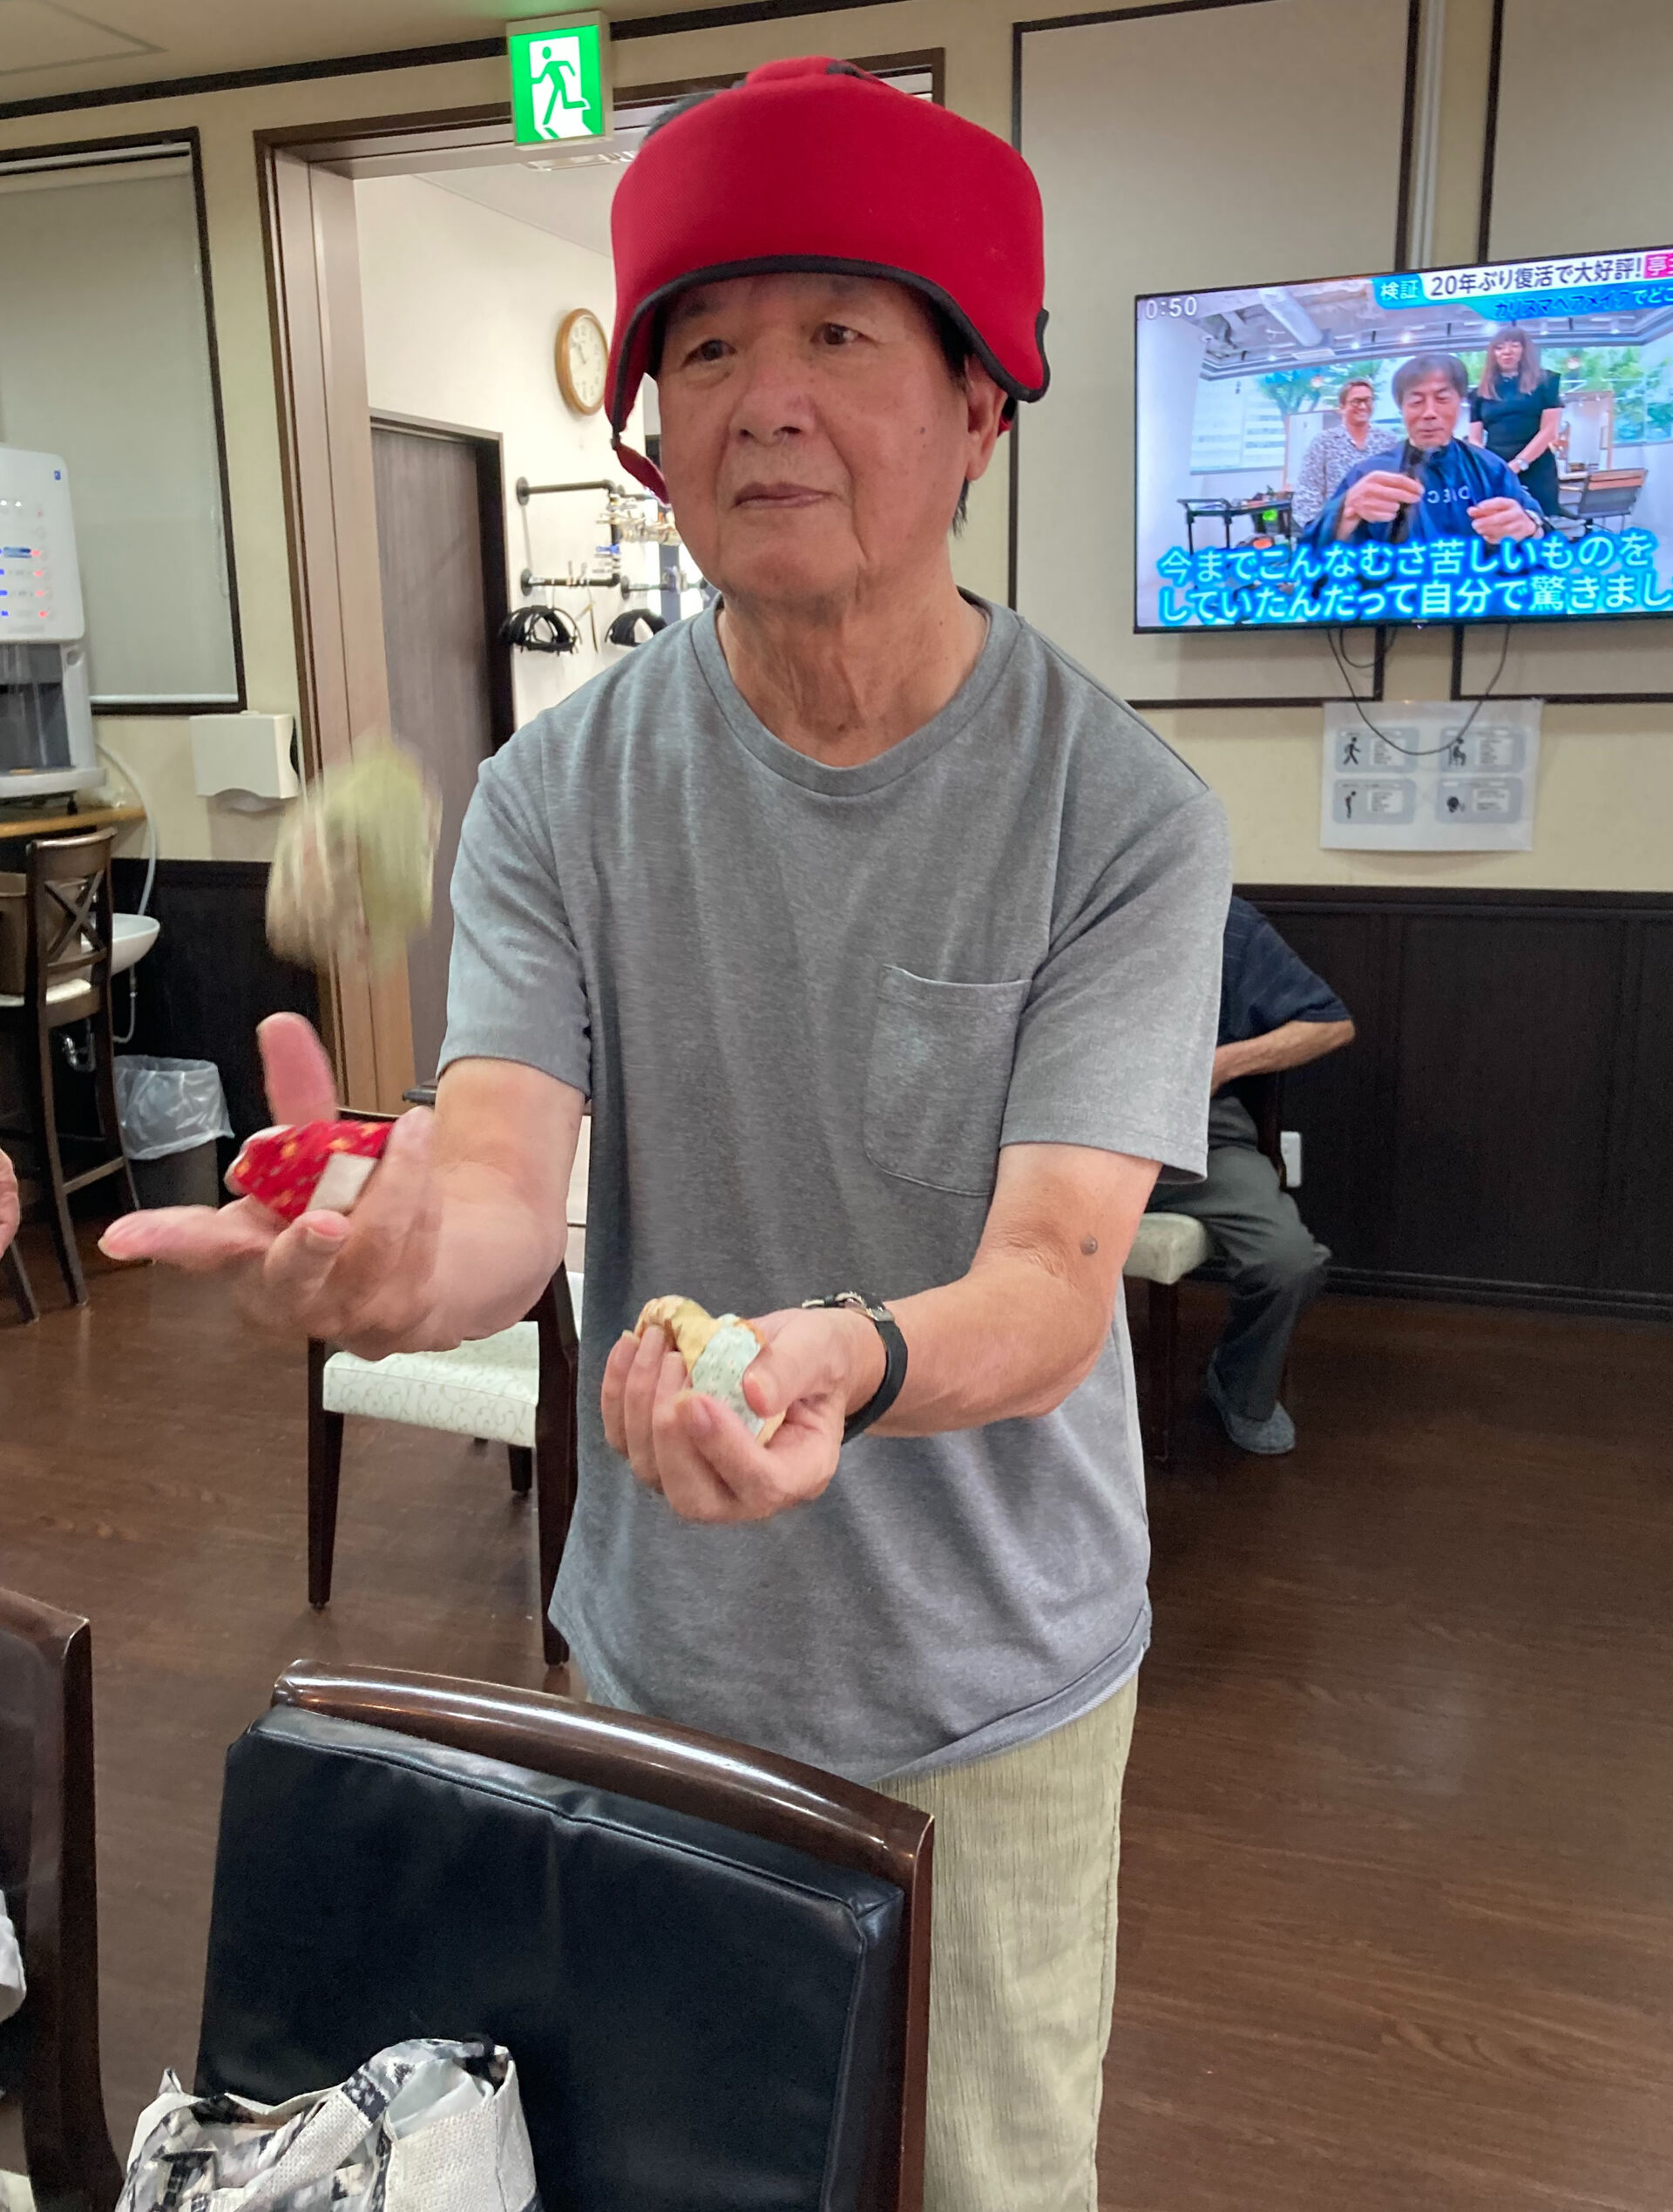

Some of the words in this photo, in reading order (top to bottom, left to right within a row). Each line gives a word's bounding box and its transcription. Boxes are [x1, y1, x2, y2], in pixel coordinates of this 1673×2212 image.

[1380, 279, 1419, 301] 検証
[1647, 254, 1673, 277] 亭
[1160, 532, 1653, 585] 今までこんなむさ苦しいものを
